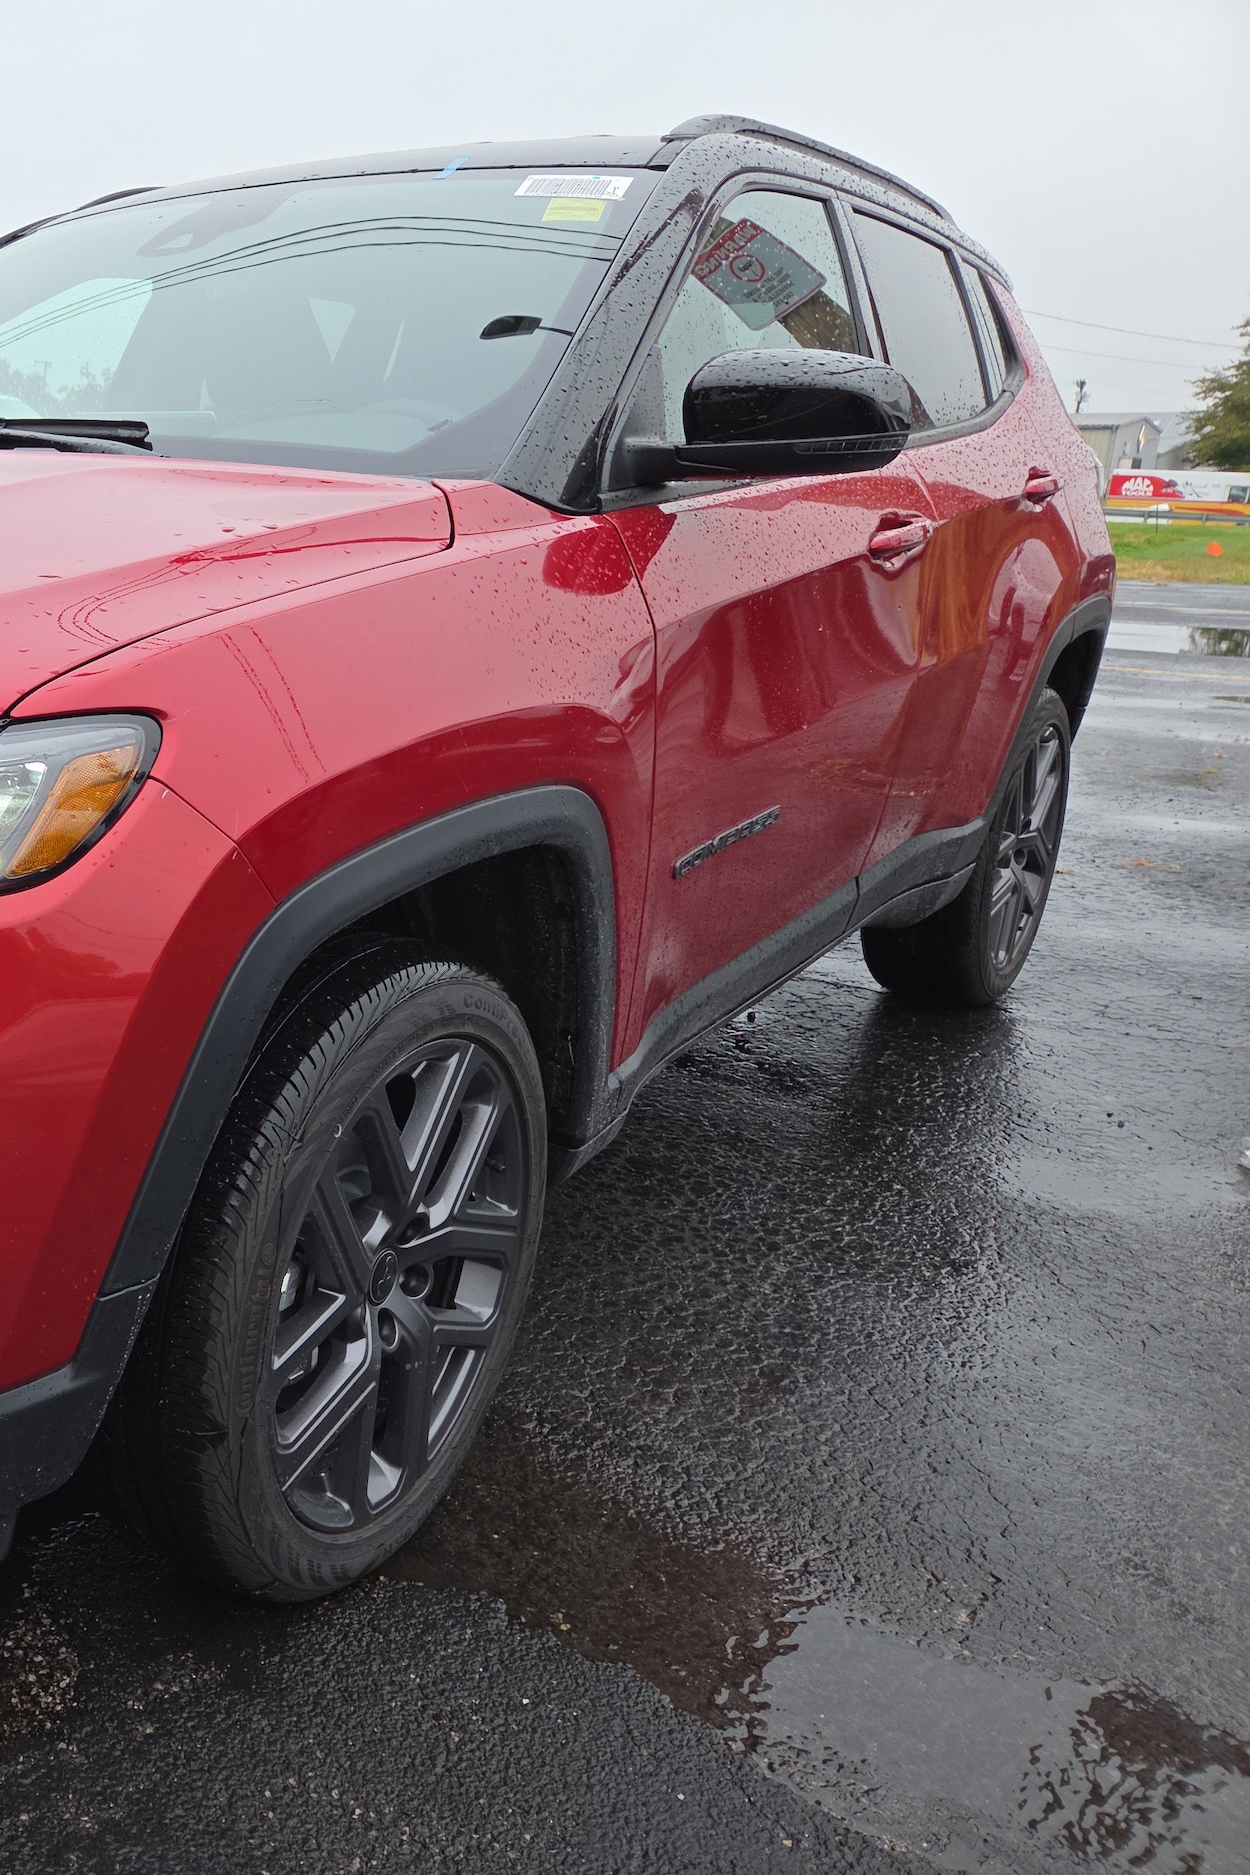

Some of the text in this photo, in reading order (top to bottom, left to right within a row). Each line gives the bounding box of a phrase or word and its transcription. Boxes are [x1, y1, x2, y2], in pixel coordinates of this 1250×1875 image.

[1121, 487, 1154, 497] TOOLS
[1122, 477, 1153, 489] MAC
[671, 804, 781, 879] COMPASS
[237, 1259, 268, 1420] Continental
